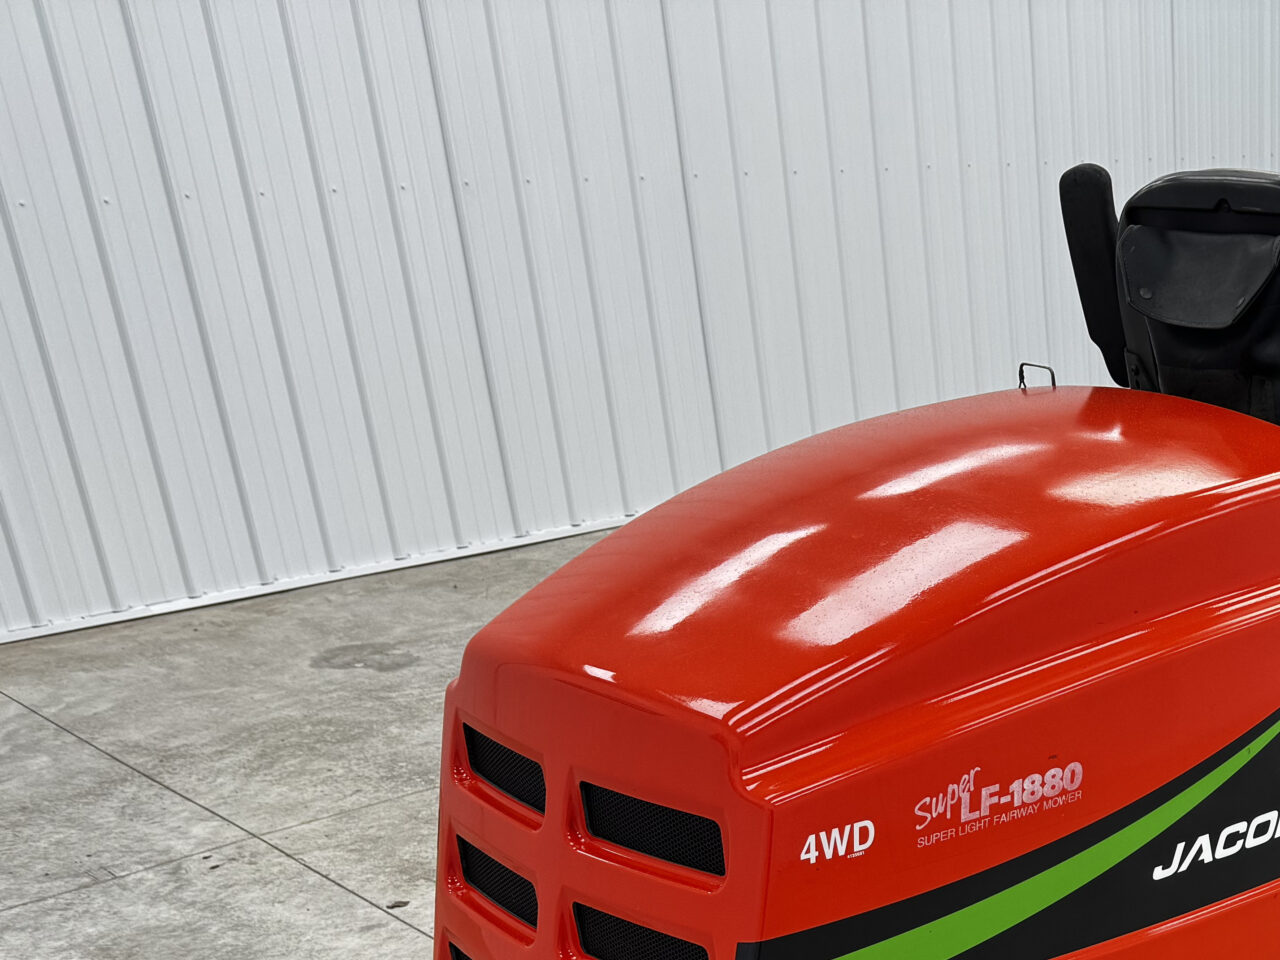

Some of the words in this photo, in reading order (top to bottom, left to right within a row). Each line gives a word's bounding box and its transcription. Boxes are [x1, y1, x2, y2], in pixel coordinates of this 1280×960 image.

[914, 766, 981, 831] Super
[917, 828, 956, 848] SUPER
[958, 816, 991, 836] LIGHT
[993, 802, 1041, 826] FAIRWAY
[1043, 790, 1082, 811] MOWER
[960, 761, 1083, 824] LF-1880
[800, 819, 875, 865] 4WD
